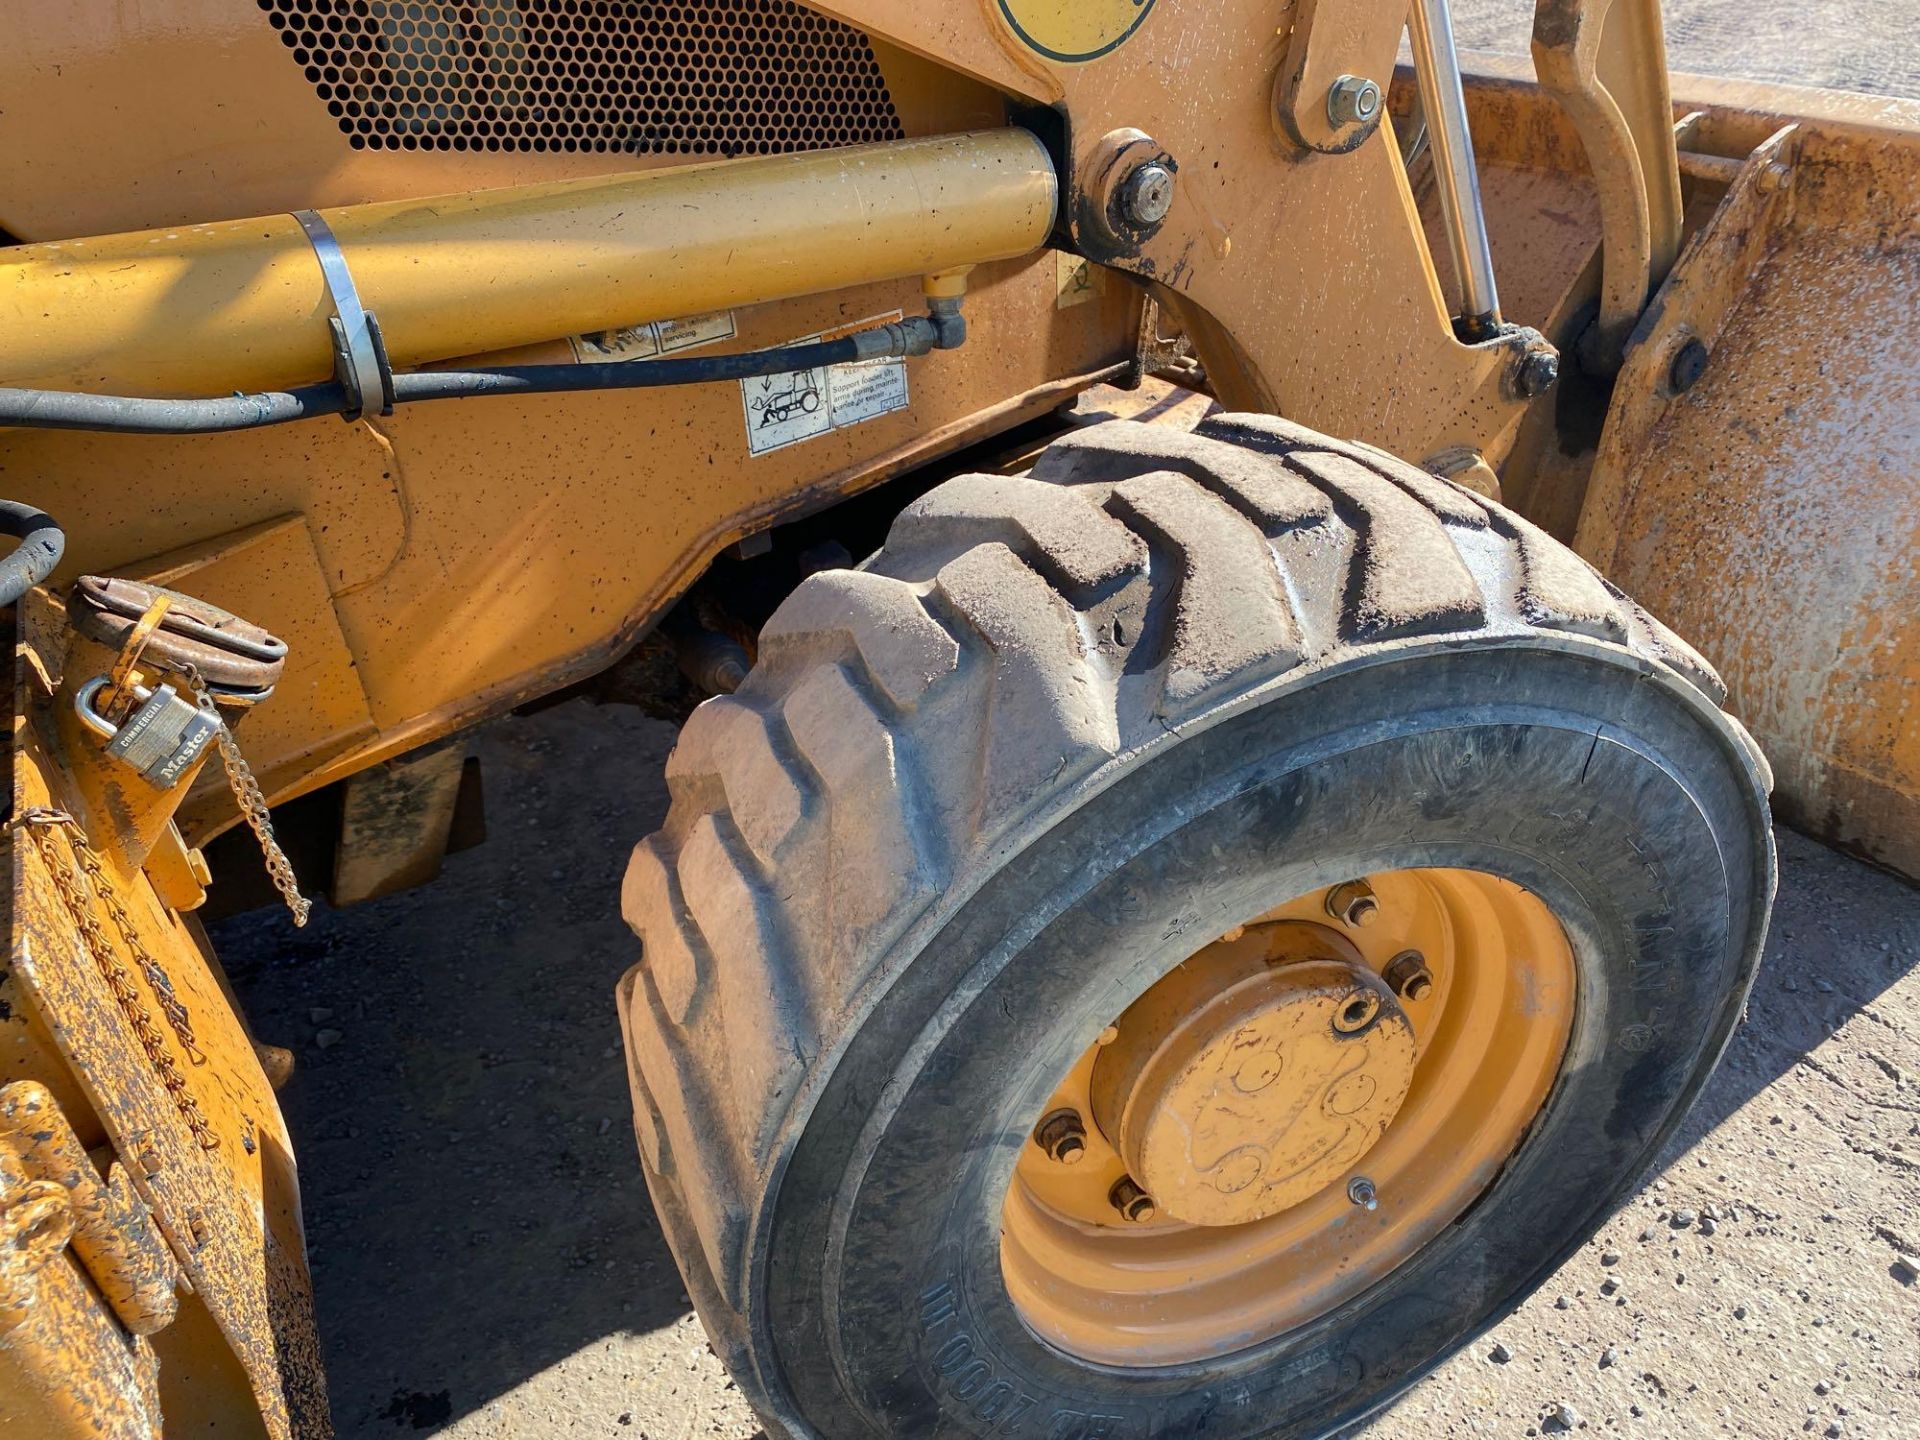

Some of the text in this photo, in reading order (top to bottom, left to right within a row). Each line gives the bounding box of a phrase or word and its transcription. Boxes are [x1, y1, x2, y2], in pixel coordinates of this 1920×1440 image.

[832, 380, 859, 392] Support
[833, 393, 851, 403] arms
[852, 386, 875, 398] during
[120, 702, 163, 748] COMMERCIAL
[160, 726, 209, 779] Master
